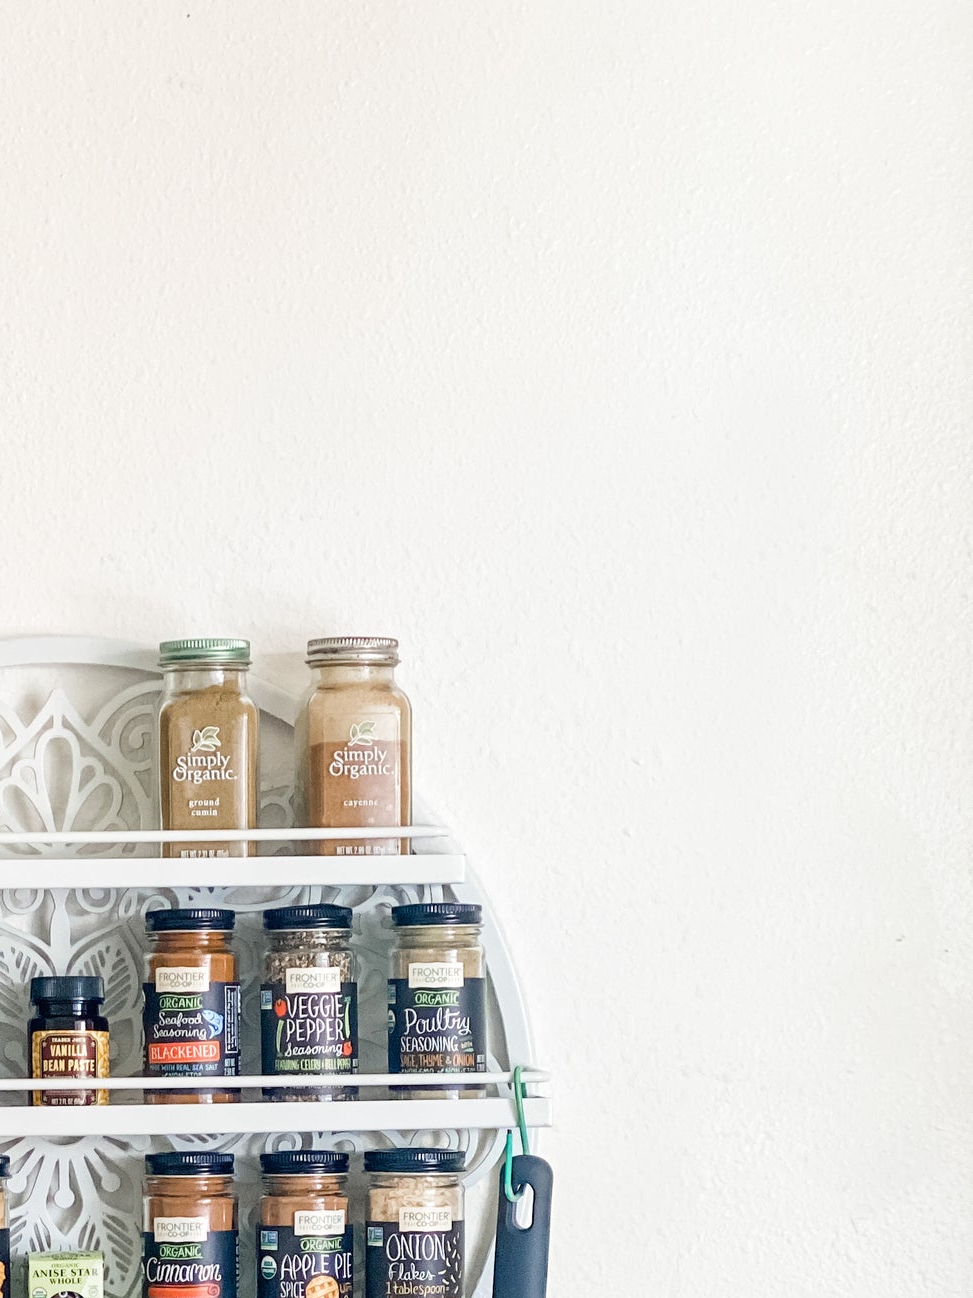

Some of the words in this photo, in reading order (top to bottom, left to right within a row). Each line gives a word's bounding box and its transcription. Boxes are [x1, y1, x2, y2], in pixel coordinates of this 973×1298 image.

[177, 752, 230, 772] Simply
[333, 746, 387, 767] Simply
[189, 798, 220, 808] ground
[344, 799, 378, 808] cayenne
[159, 972, 204, 980] FRONTIER
[290, 973, 337, 982] FRONTIER
[412, 968, 459, 976] FRONTIER
[160, 997, 203, 1008] ORGANIC
[415, 993, 459, 1004] ORGANIC
[285, 995, 344, 1018] VEGGIE
[158, 1012, 203, 1026] Seafood
[404, 1007, 472, 1035] Poultry
[153, 1024, 207, 1040] Seasoning
[286, 1019, 344, 1042] PEPPER
[285, 1041, 343, 1057] Seasoning
[401, 1036, 459, 1052] SEASONING
[50, 1045, 87, 1057] VANILLA
[151, 1044, 217, 1060] BLACKENED
[43, 1059, 65, 1071] BEAN
[68, 1059, 95, 1071] PASTE
[419, 1054, 443, 1067] THYME
[453, 1054, 475, 1067] ONION
[299, 1215, 343, 1224] FRONTIER
[404, 1211, 449, 1220] FRONTIER
[157, 1223, 201, 1231] FRONTIER
[300, 1239, 342, 1250] ORGANIC
[386, 1233, 446, 1261] ONION
[159, 1246, 202, 1257] ORGANIC
[33, 1269, 67, 1278] ANISE
[71, 1268, 98, 1276] STAR
[147, 1257, 221, 1282] Cinnamon
[280, 1254, 329, 1280] APPLE
[335, 1253, 352, 1279] PIE
[388, 1262, 436, 1280] Flakes
[280, 1281, 305, 1298] SPICE
[386, 1281, 391, 1294] 1
[393, 1281, 445, 1297] tablespoon
